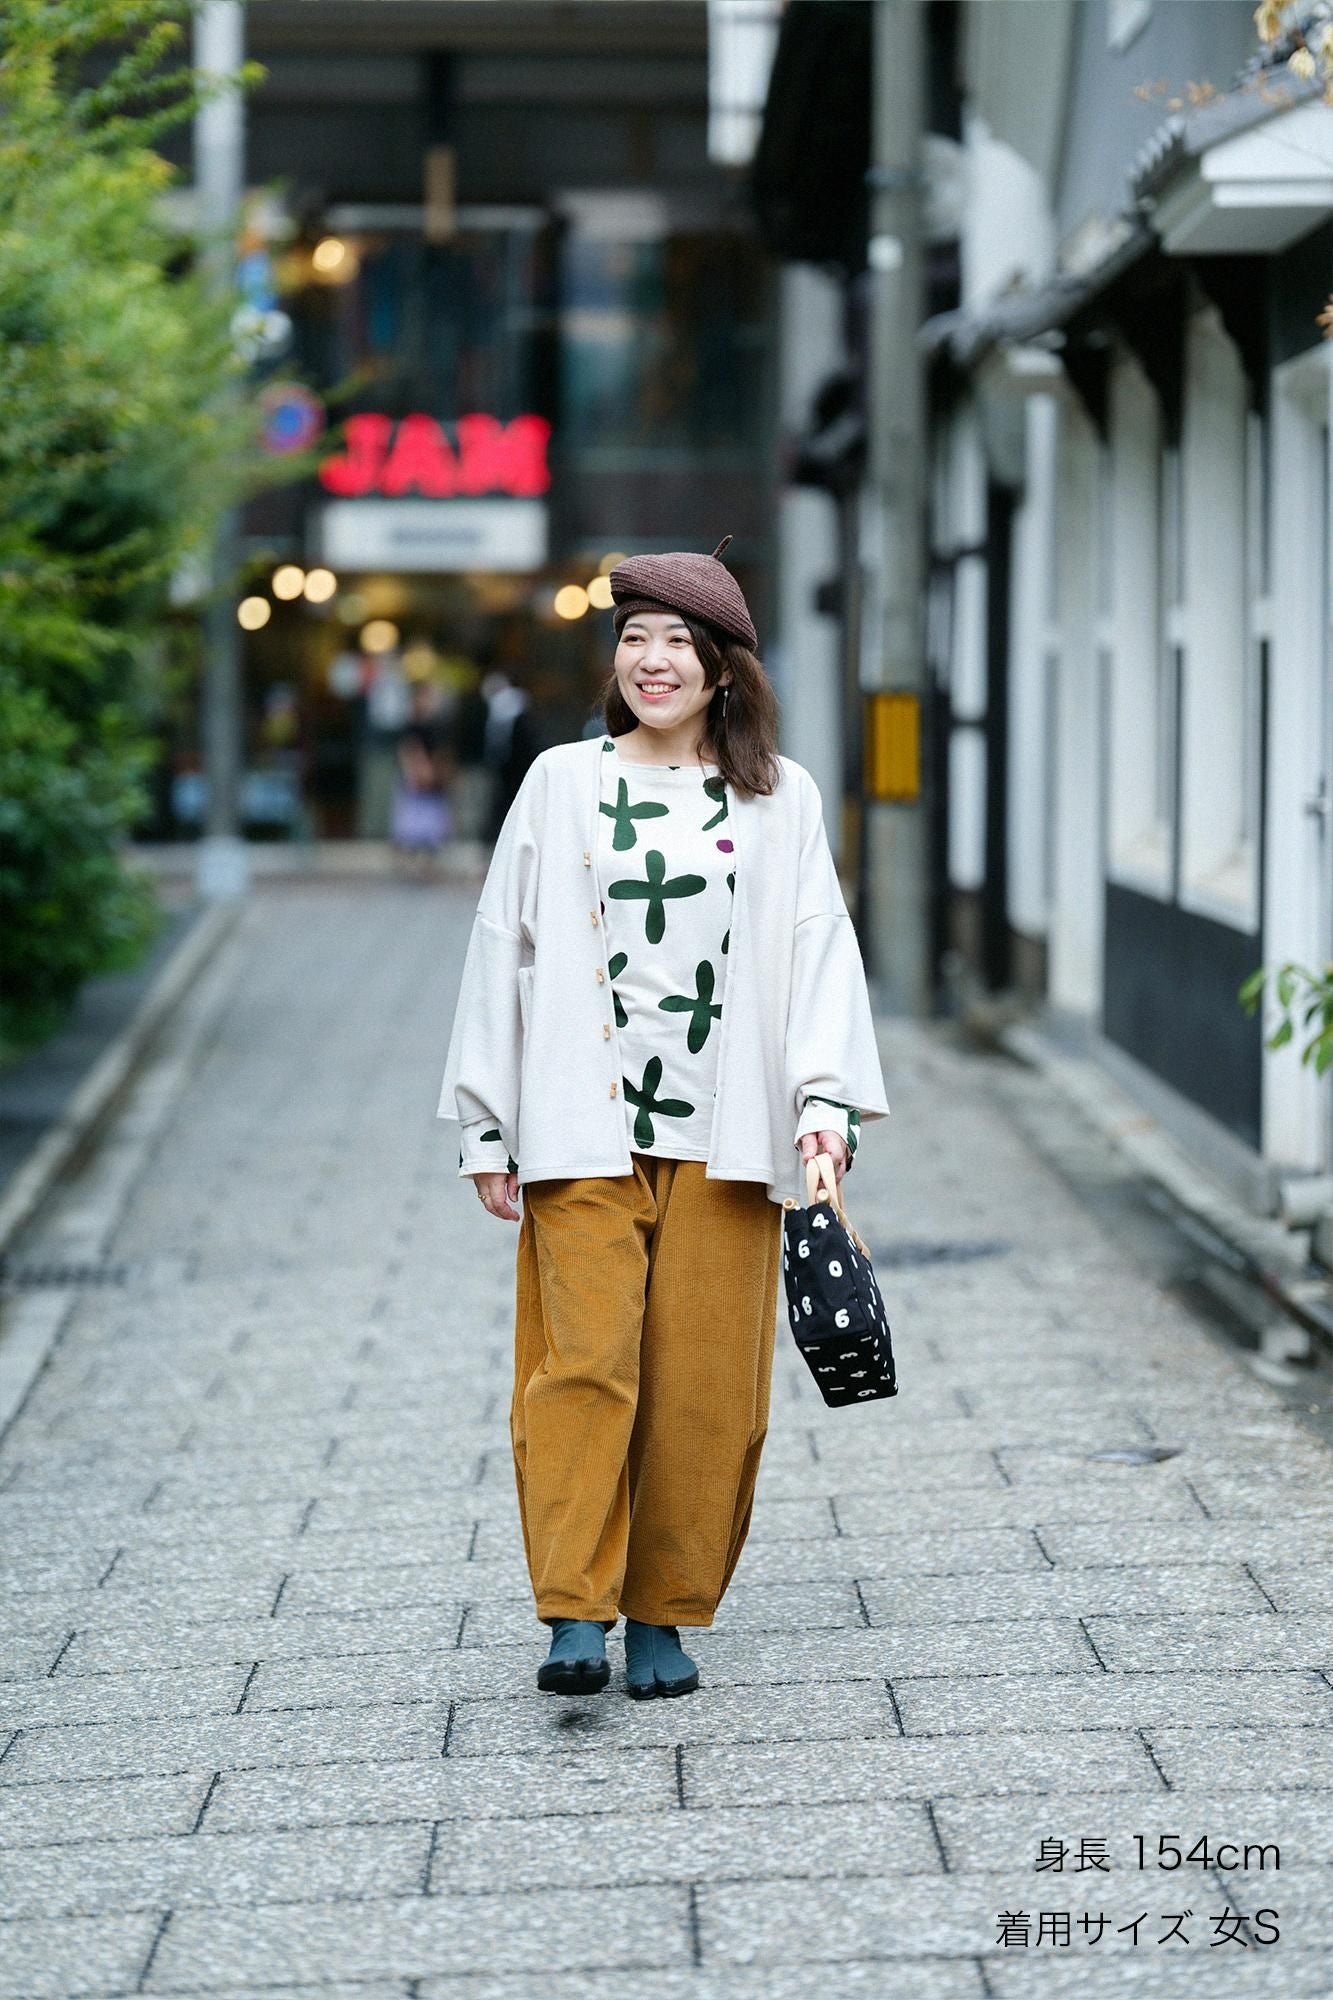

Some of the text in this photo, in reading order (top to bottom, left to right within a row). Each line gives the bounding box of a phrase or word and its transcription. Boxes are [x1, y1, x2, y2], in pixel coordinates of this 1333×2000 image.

[318, 412, 552, 498] JAM
[812, 1213, 829, 1229] 4
[798, 1239, 810, 1258] 6
[829, 1260, 842, 1277] 0
[835, 1309, 849, 1328] 6
